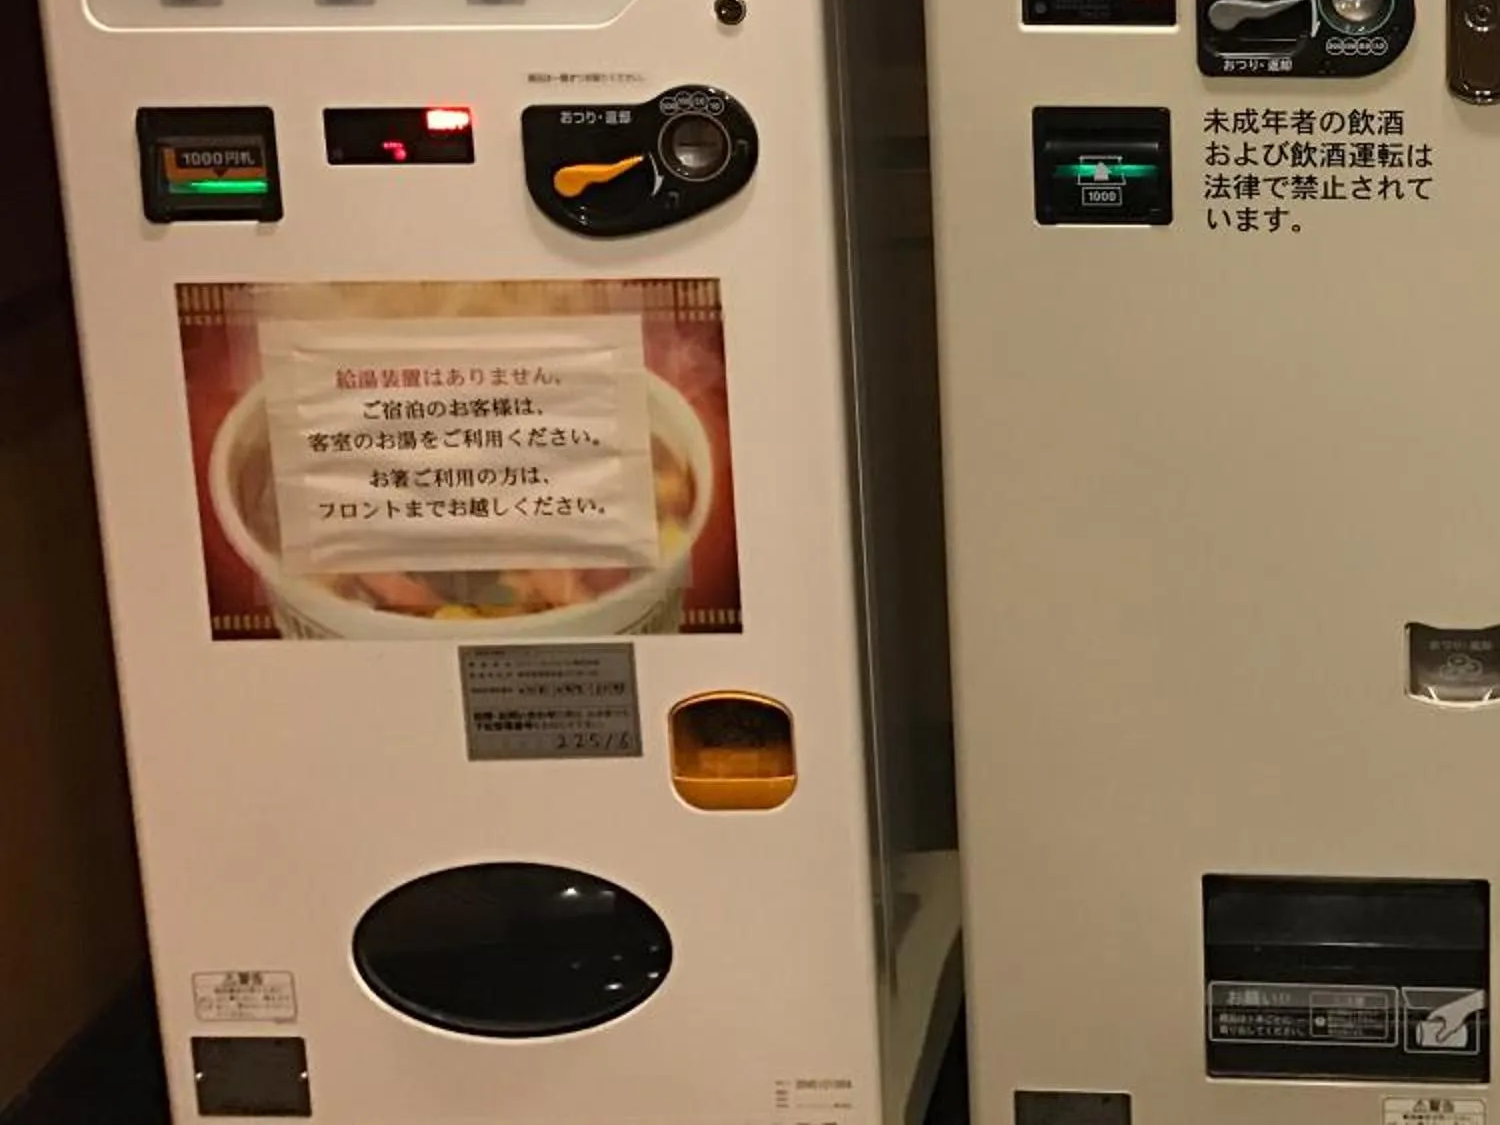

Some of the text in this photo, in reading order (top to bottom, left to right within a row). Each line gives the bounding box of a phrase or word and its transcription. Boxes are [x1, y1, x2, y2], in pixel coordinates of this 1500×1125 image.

[1204, 109, 1405, 135] 未成年者の飲酒
[1205, 142, 1434, 168] および飲酒運転は
[1204, 175, 1433, 201] 法律で禁止されて
[1207, 207, 1304, 233] います。
[335, 367, 562, 390] 給湯装置はありません。
[362, 398, 544, 421] ご宿泊のお客様は、
[308, 428, 602, 453] 客室のお湯をご利用ください。
[369, 467, 551, 490] お箸ご利用の方は、
[318, 497, 607, 522] フロントまでお越しください。
